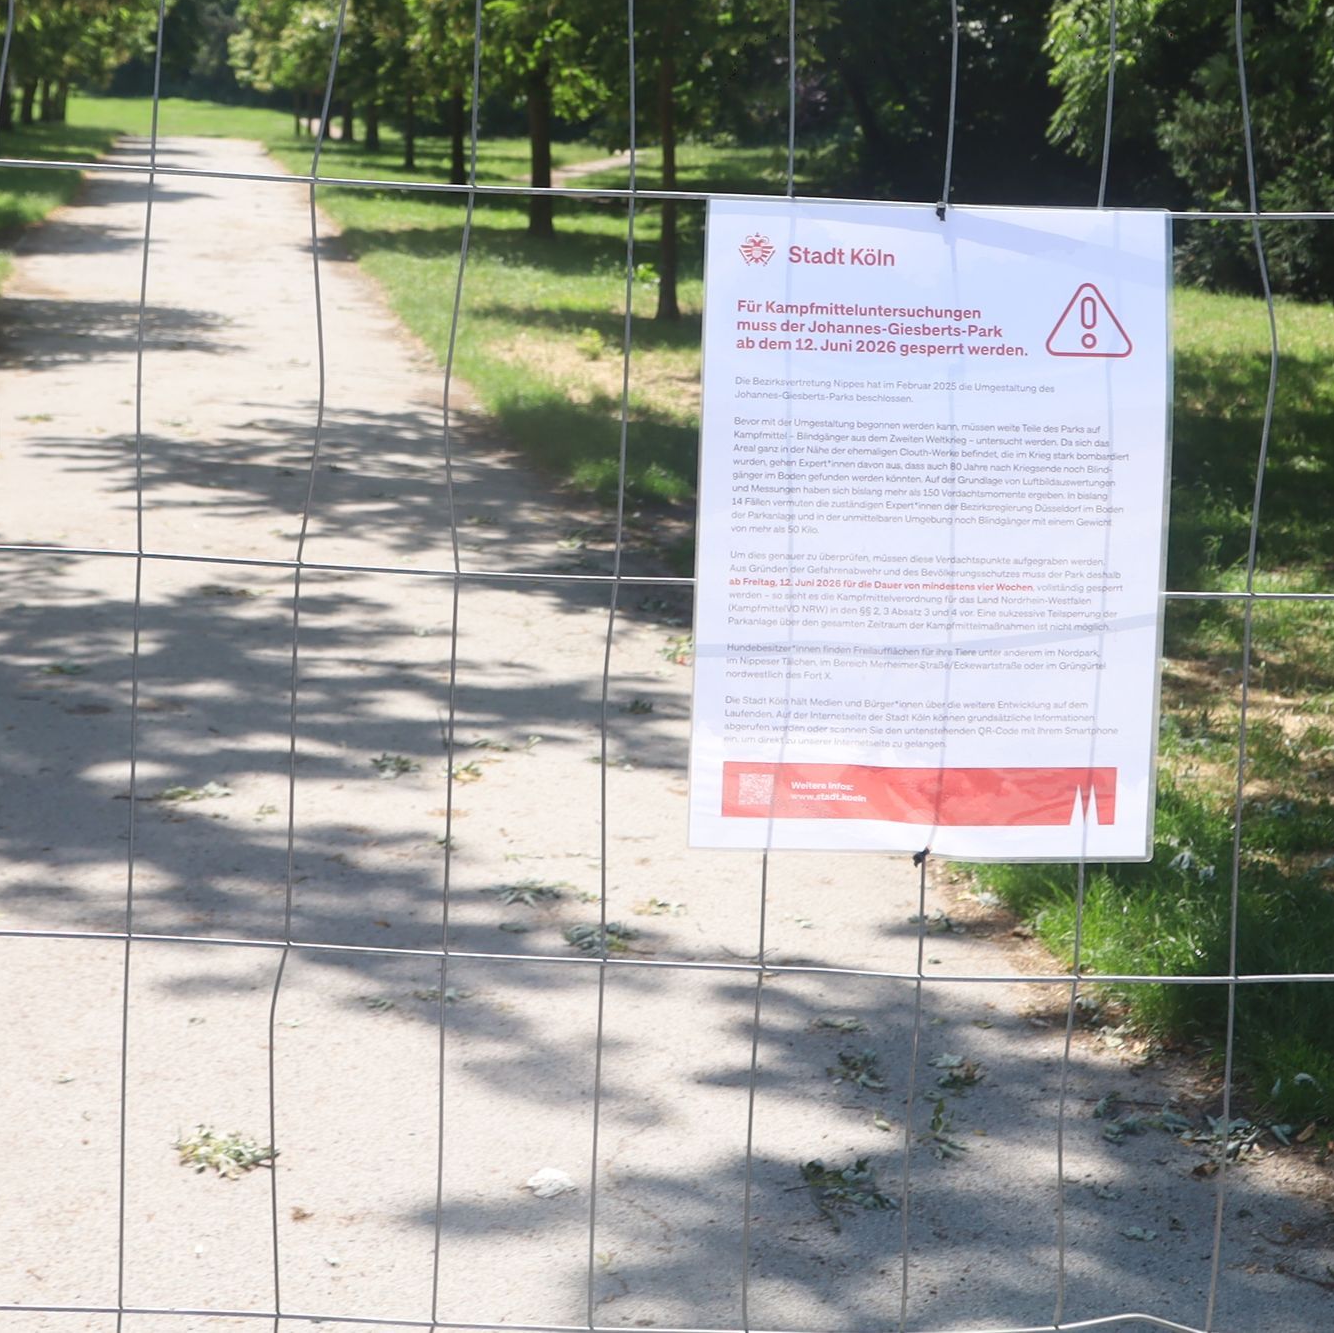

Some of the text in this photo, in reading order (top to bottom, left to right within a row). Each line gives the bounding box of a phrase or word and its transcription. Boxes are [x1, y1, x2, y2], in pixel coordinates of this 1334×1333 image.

[789, 246, 895, 266] Stadt Köln
[737, 300, 981, 321] Für Kampfmitteluntersuchungen
[736, 319, 1003, 337] muss der Johannes-Giesberts-Park
[736, 336, 1028, 357] ab dem 12. Juni 2026 gesperrt werden.
[735, 377, 750, 385] Die
[752, 377, 831, 388] Bezirksvertretung
[833, 379, 864, 389] Nippes
[866, 380, 881, 388] hat
[896, 381, 931, 389] Februar
[933, 382, 956, 390] 2025
[974, 383, 1036, 394] Umgestaltung
[734, 390, 853, 401] Johannes-Giesberts-Parks
[728, 577, 740, 585] ab
[816, 579, 841, 587] 2026
[843, 579, 855, 587] für
[874, 580, 901, 588] Dauer
[922, 581, 975, 589] mindestens
[977, 582, 993, 590] vier
[1036, 583, 1084, 593] vollständig
[1085, 584, 1122, 594] gesperrt
[791, 781, 827, 790] Weitere
